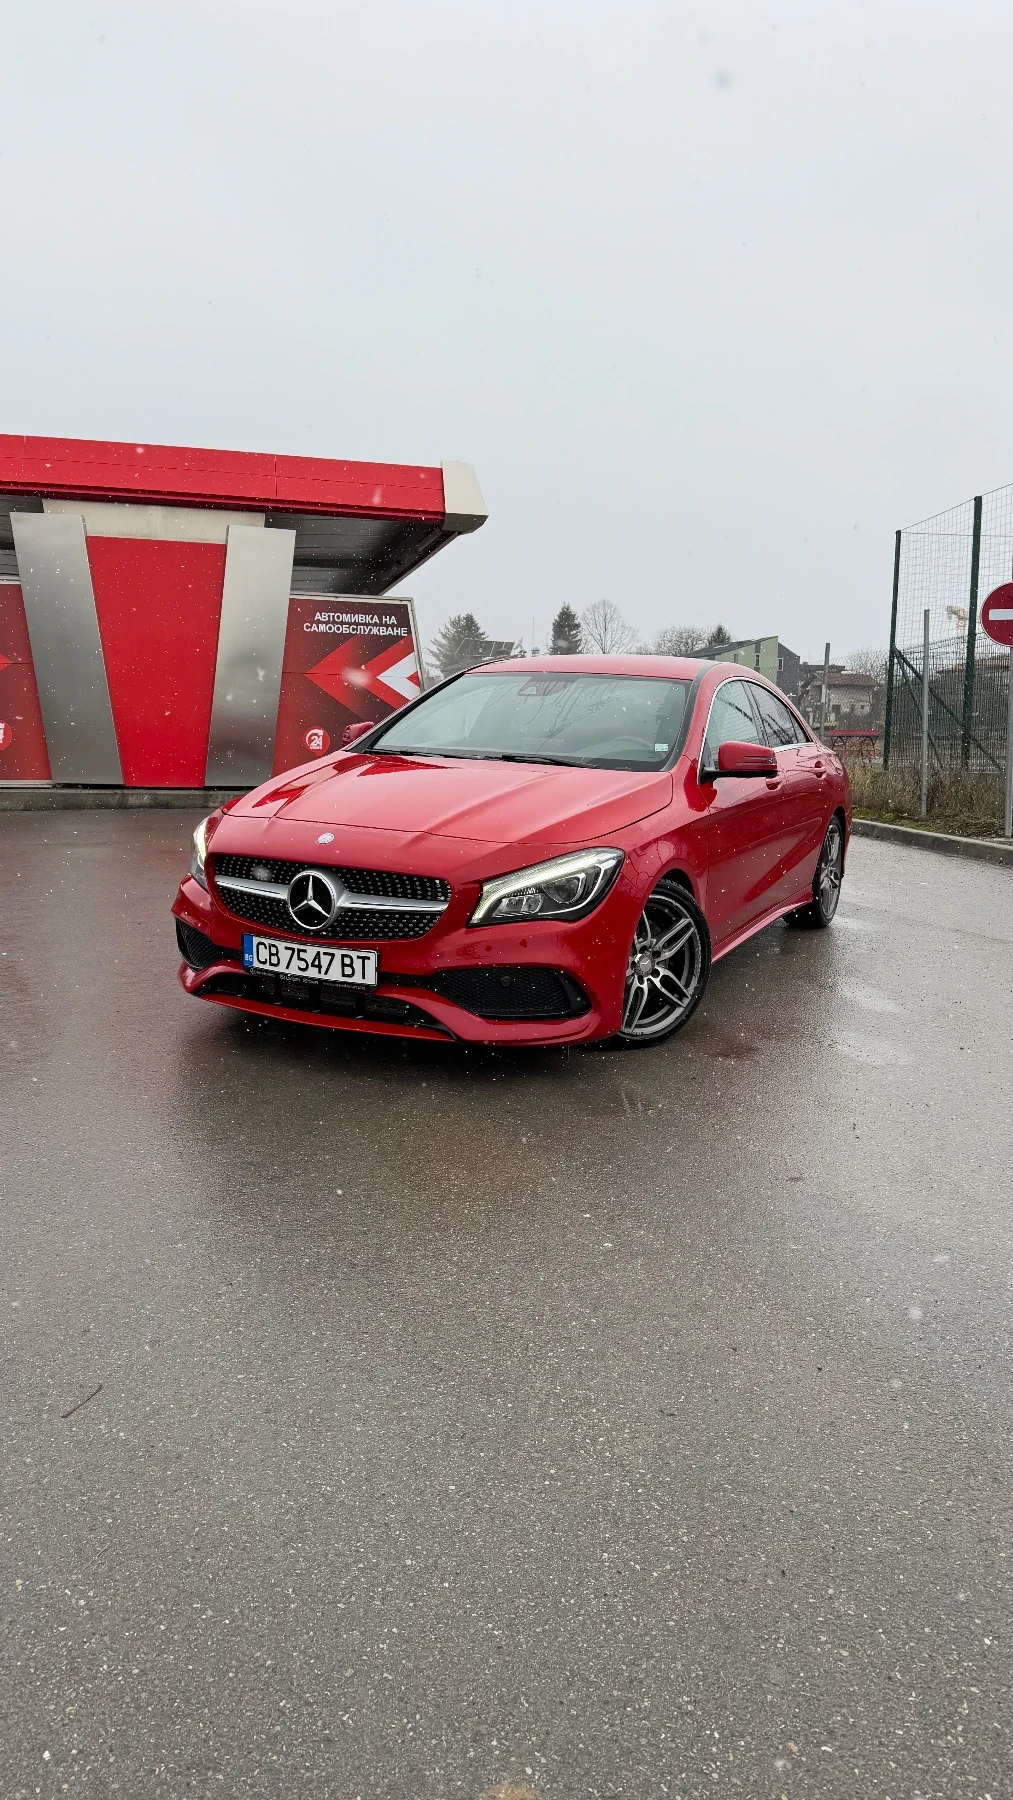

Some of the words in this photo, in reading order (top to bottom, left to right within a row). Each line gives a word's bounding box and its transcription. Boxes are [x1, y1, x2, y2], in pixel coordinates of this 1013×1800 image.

[314, 612, 380, 624] АВТОМИВКА
[382, 615, 398, 625] НА
[303, 622, 408, 637] САМООБСЛУЖВАНЕ
[310, 735, 323, 747] 24
[255, 941, 280, 967] CB
[284, 945, 336, 975] 7547
[340, 953, 371, 980] BT
